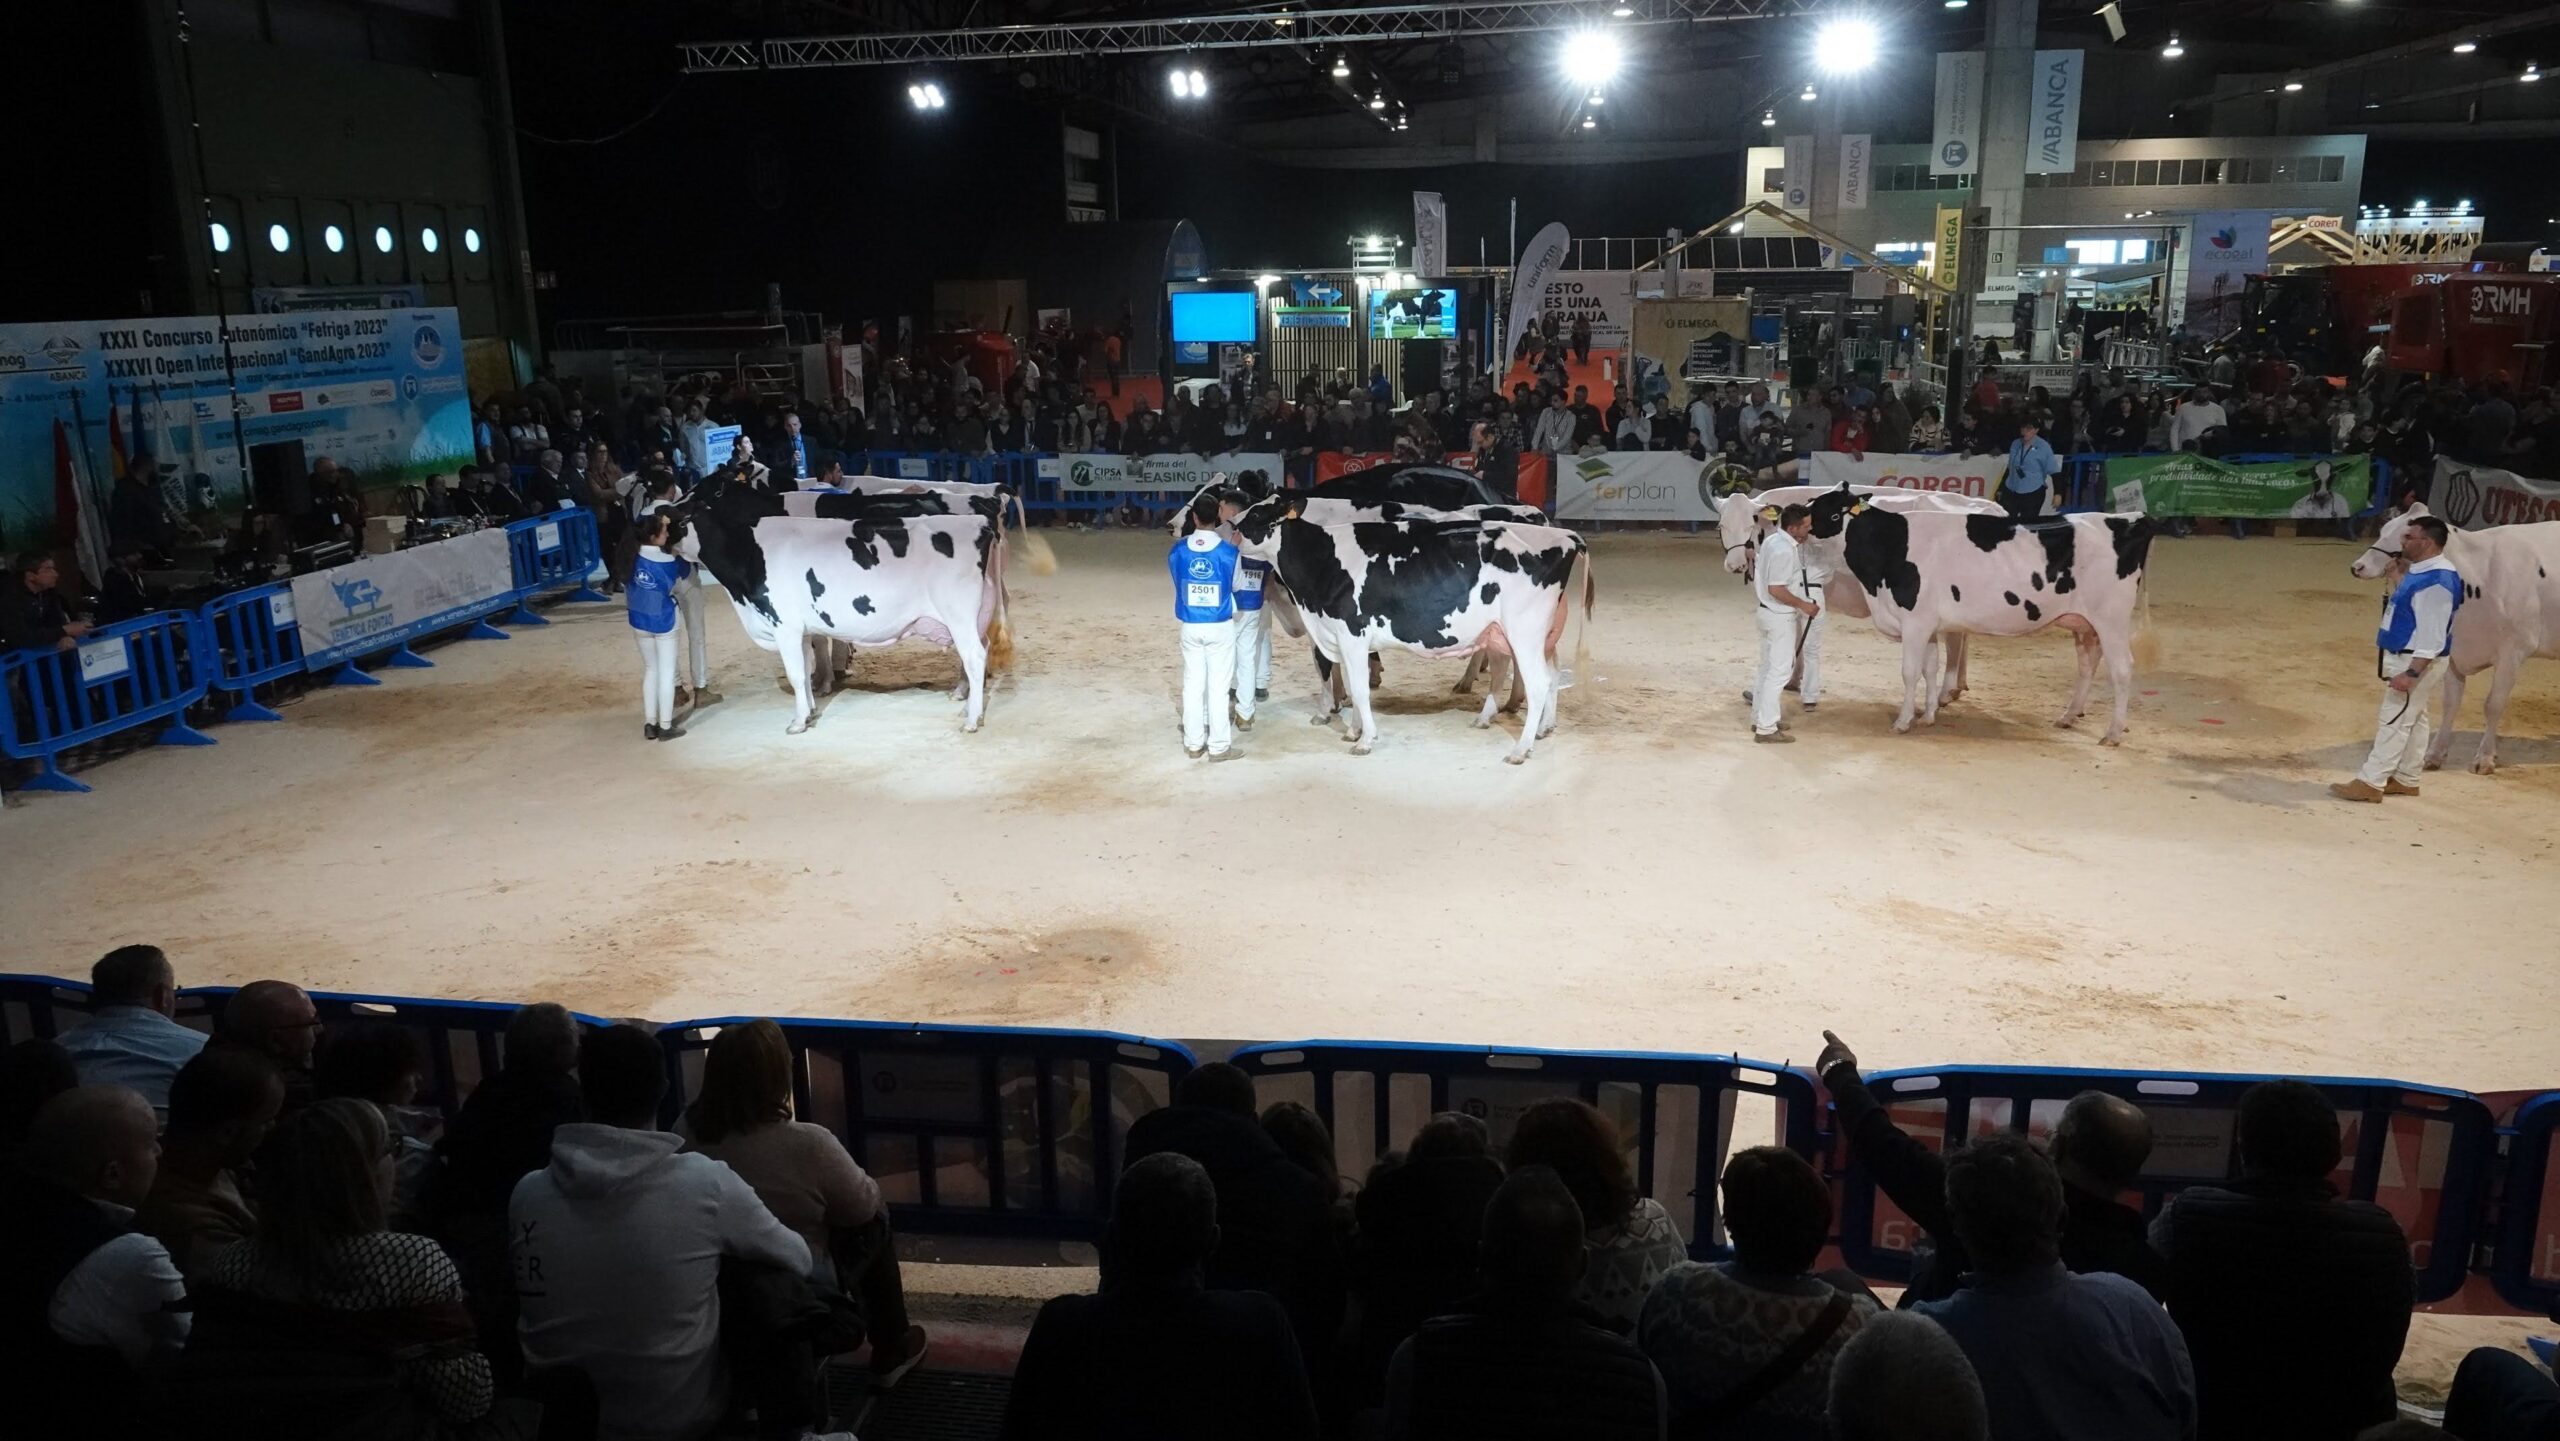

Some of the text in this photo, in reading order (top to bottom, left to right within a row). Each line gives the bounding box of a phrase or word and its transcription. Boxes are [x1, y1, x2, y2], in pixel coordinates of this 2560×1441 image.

[1945, 216, 1958, 268] ELMEGA
[2205, 247, 2253, 262] ecogal
[1527, 244, 1558, 288] uniform
[1545, 283, 1583, 295] ESTO
[1545, 297, 1602, 308] ES UNA
[99, 330, 137, 350] XXXI
[143, 329, 213, 348] Concurso
[104, 360, 152, 379] XXXVI
[156, 357, 192, 378] Open
[197, 351, 287, 372] Intenacional
[2044, 368, 2073, 377] ELMEG
[1146, 460, 1188, 469] firma del
[1094, 467, 1122, 476] CIPSA
[1136, 472, 1196, 483] EASING
[1595, 481, 1676, 503] ferplan
[1191, 585, 1215, 594] 2501
